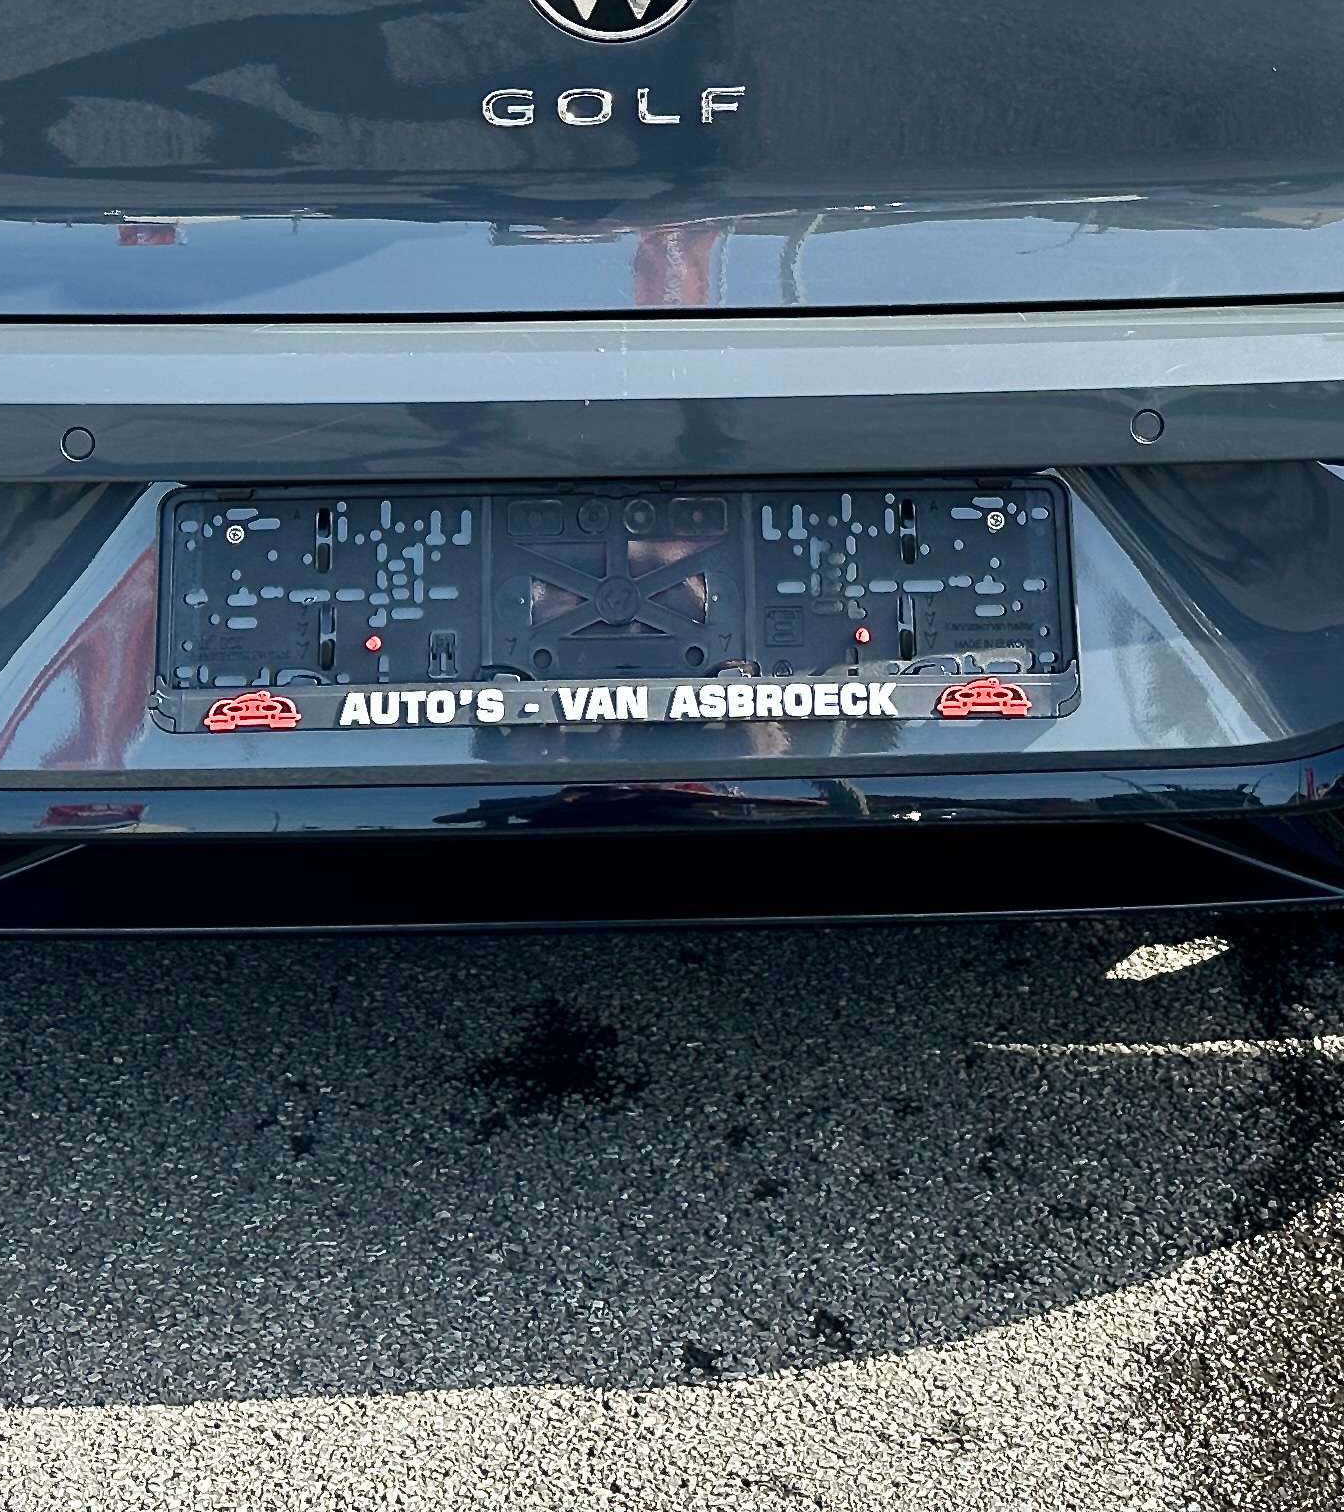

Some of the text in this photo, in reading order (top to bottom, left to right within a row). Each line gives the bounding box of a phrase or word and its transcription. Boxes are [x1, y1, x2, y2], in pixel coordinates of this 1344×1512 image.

[482, 86, 746, 127] GOLF
[339, 689, 505, 727] AUTO'S
[557, 686, 649, 722] VAN
[669, 682, 899, 720] ASBROECK
